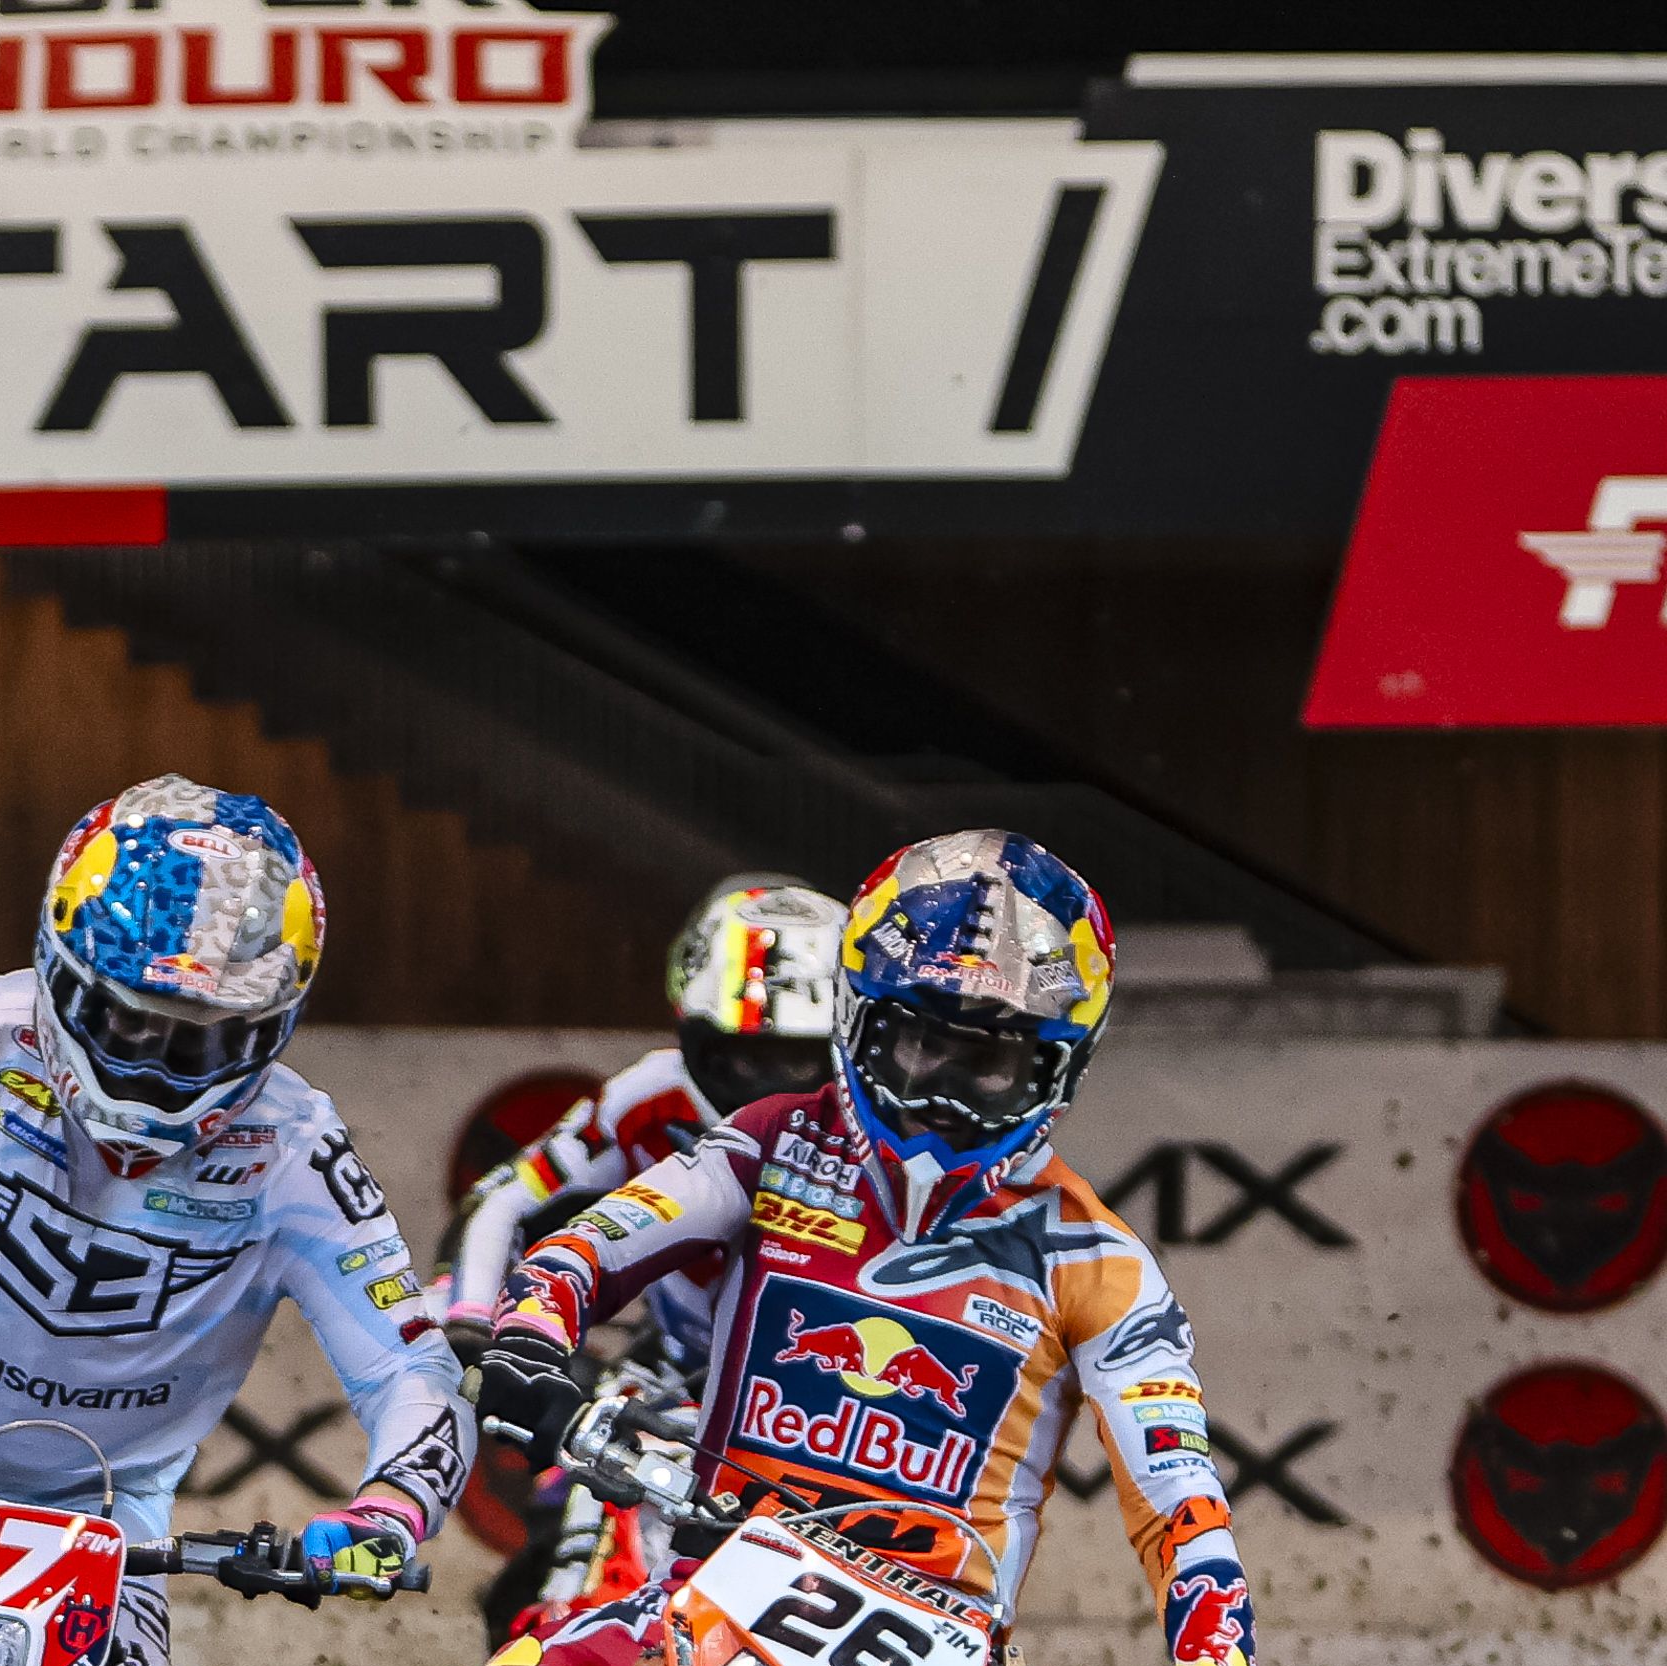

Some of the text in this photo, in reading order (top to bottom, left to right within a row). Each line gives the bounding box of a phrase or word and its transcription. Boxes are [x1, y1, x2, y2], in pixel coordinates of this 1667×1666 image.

[129, 119, 557, 158] CHAMPIONSHIP
[1309, 295, 1485, 355] .com
[180, 834, 234, 856] BELL
[754, 1198, 840, 1242] DHL
[739, 1374, 978, 1497] Red Bull
[73, 1530, 122, 1556] FIM
[931, 1618, 983, 1660] FIM
